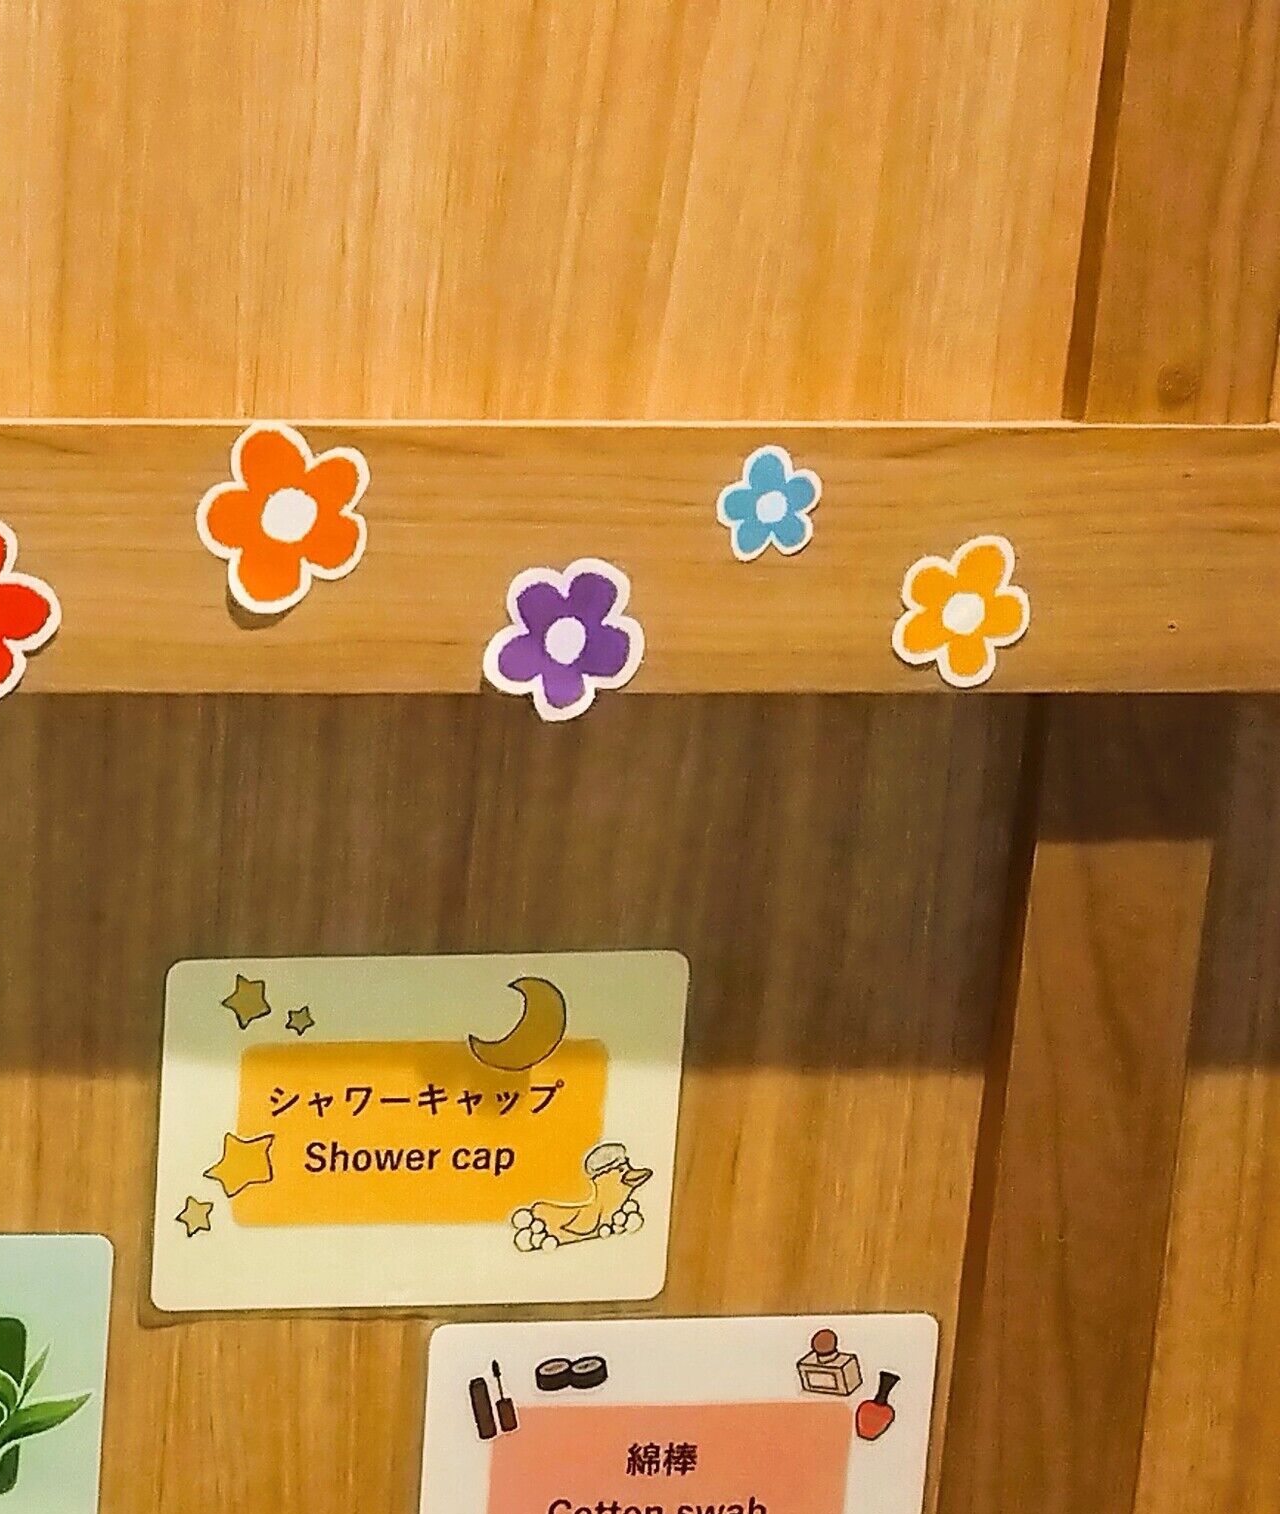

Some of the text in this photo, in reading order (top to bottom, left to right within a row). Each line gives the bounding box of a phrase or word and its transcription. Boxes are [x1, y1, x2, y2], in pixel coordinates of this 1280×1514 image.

[270, 1078, 565, 1118] シャワーキャップ
[304, 1141, 515, 1177] Shower cap
[625, 1442, 699, 1477] 綿棒
